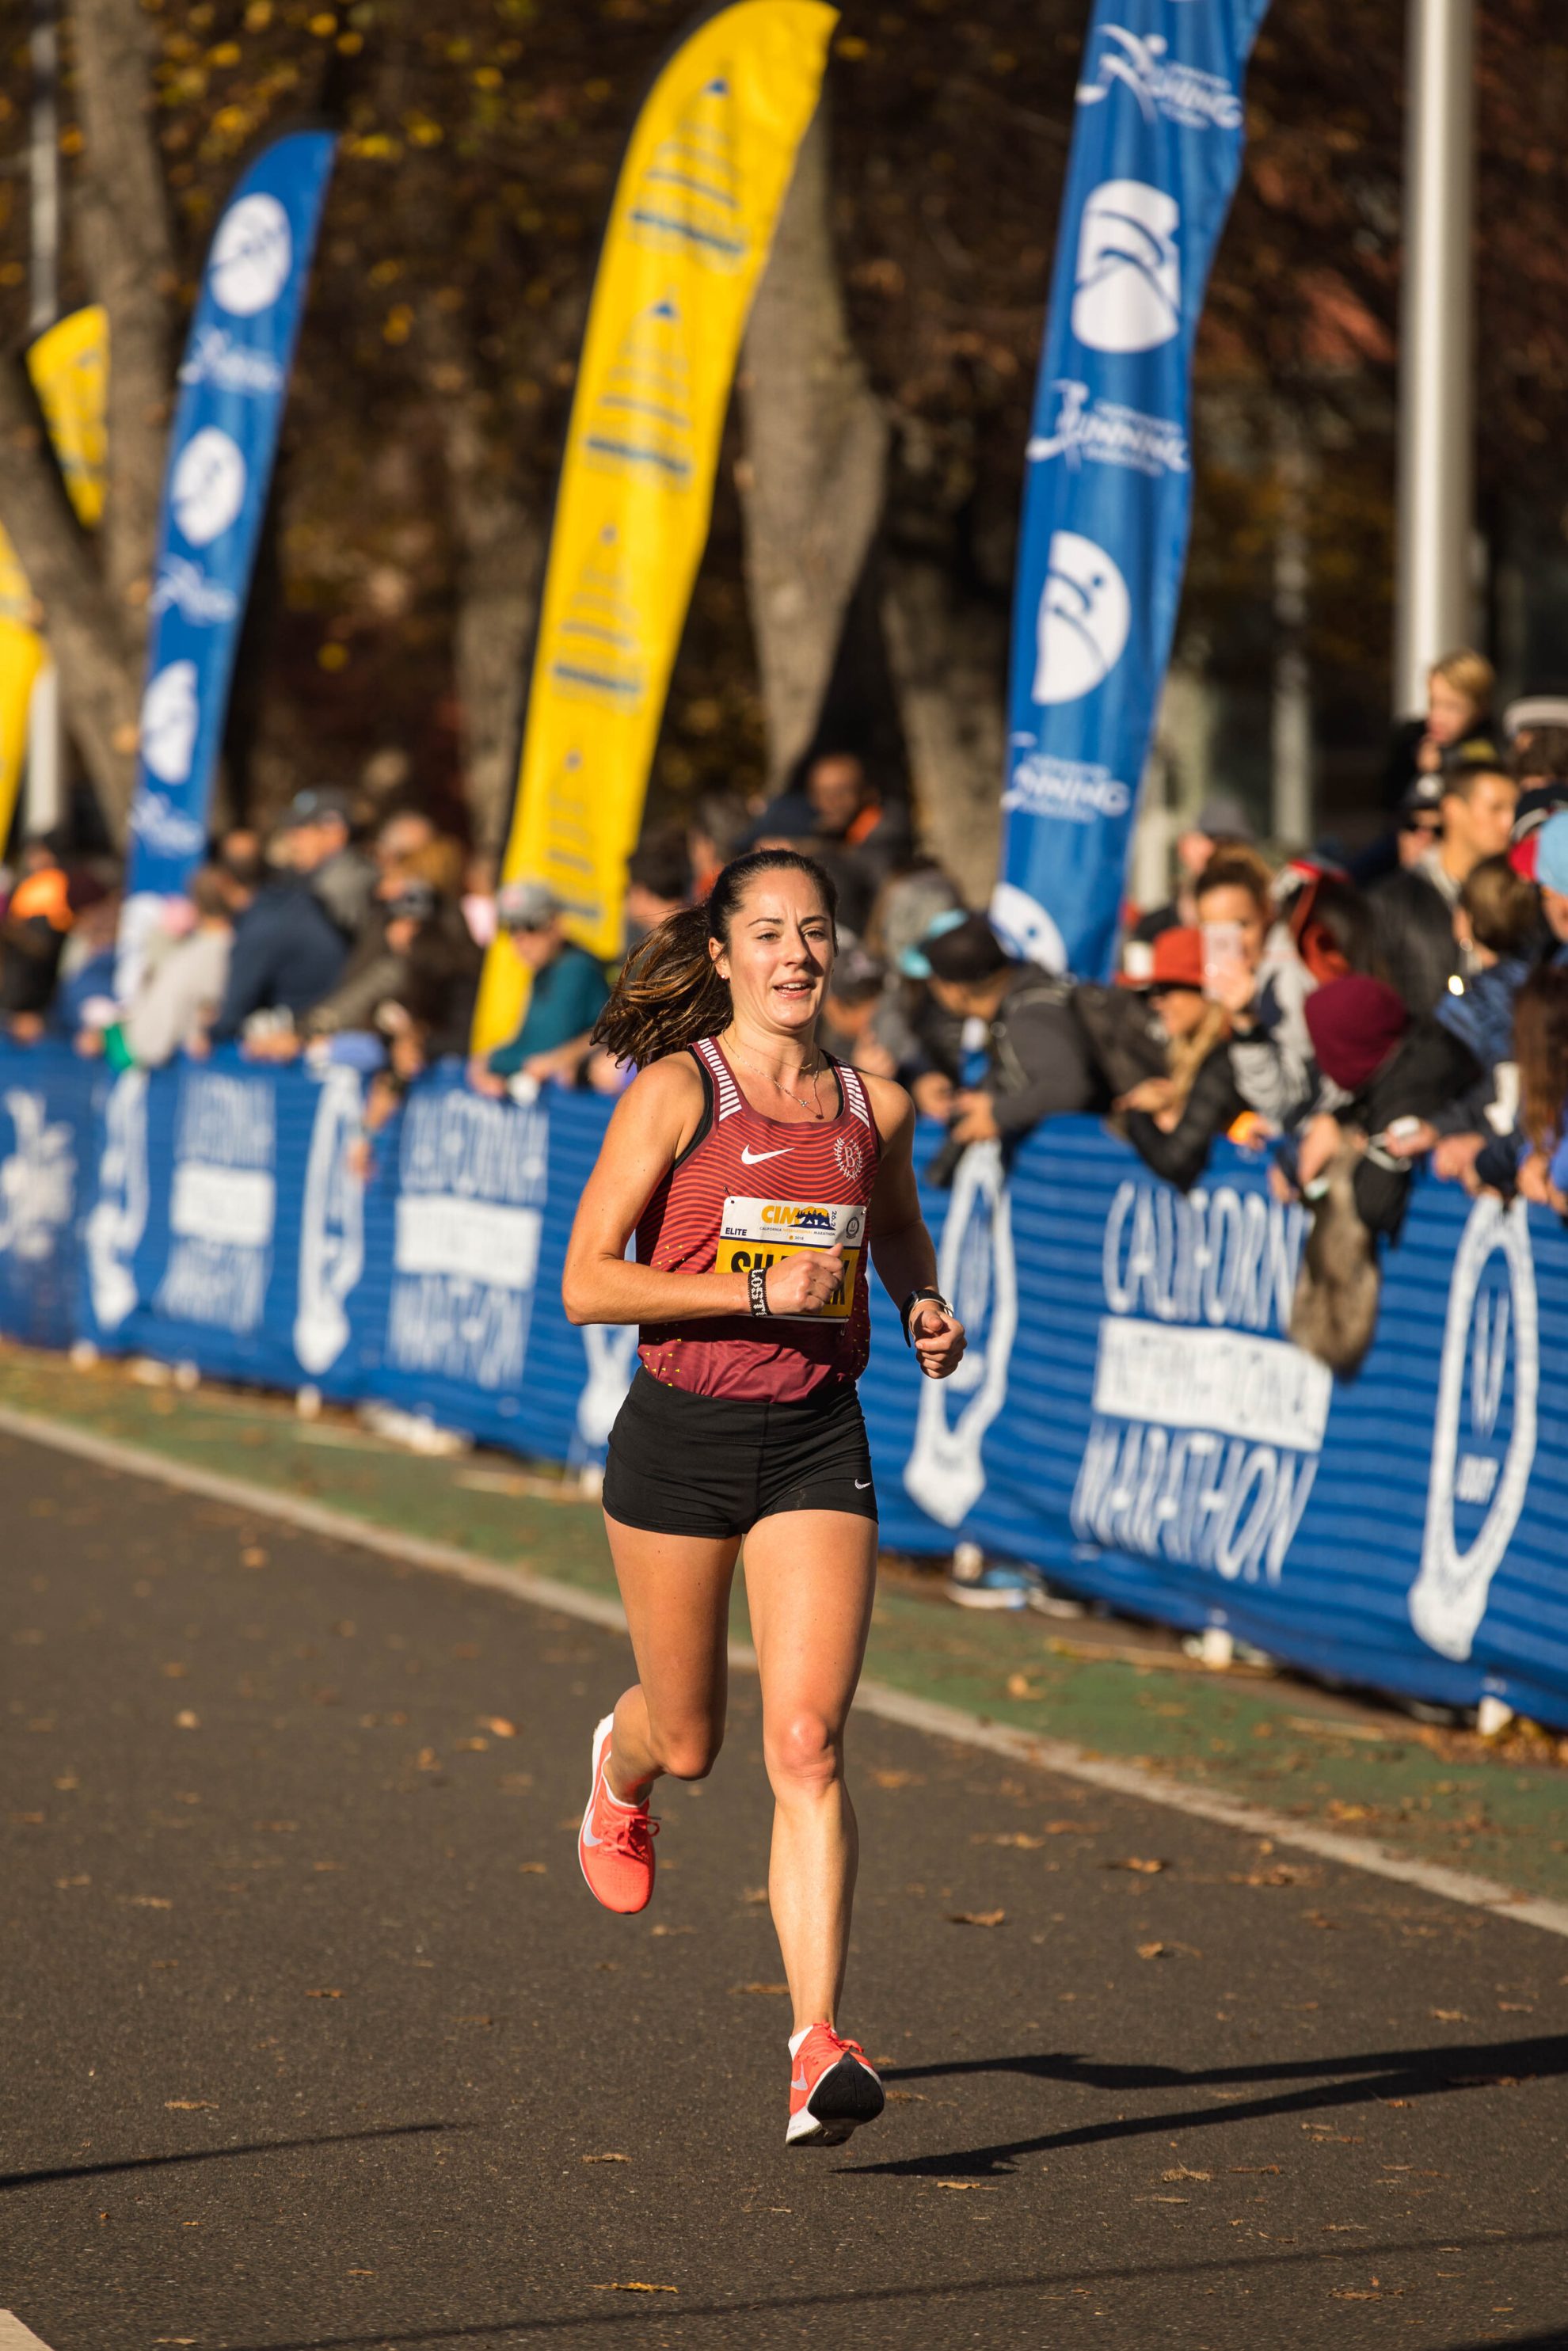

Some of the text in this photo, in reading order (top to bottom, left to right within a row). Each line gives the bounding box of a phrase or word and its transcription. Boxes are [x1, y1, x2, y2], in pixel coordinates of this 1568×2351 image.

[761, 1204, 801, 1225] CIM
[725, 1227, 748, 1236] ELITE
[1102, 1180, 1316, 1332] CALIFORN
